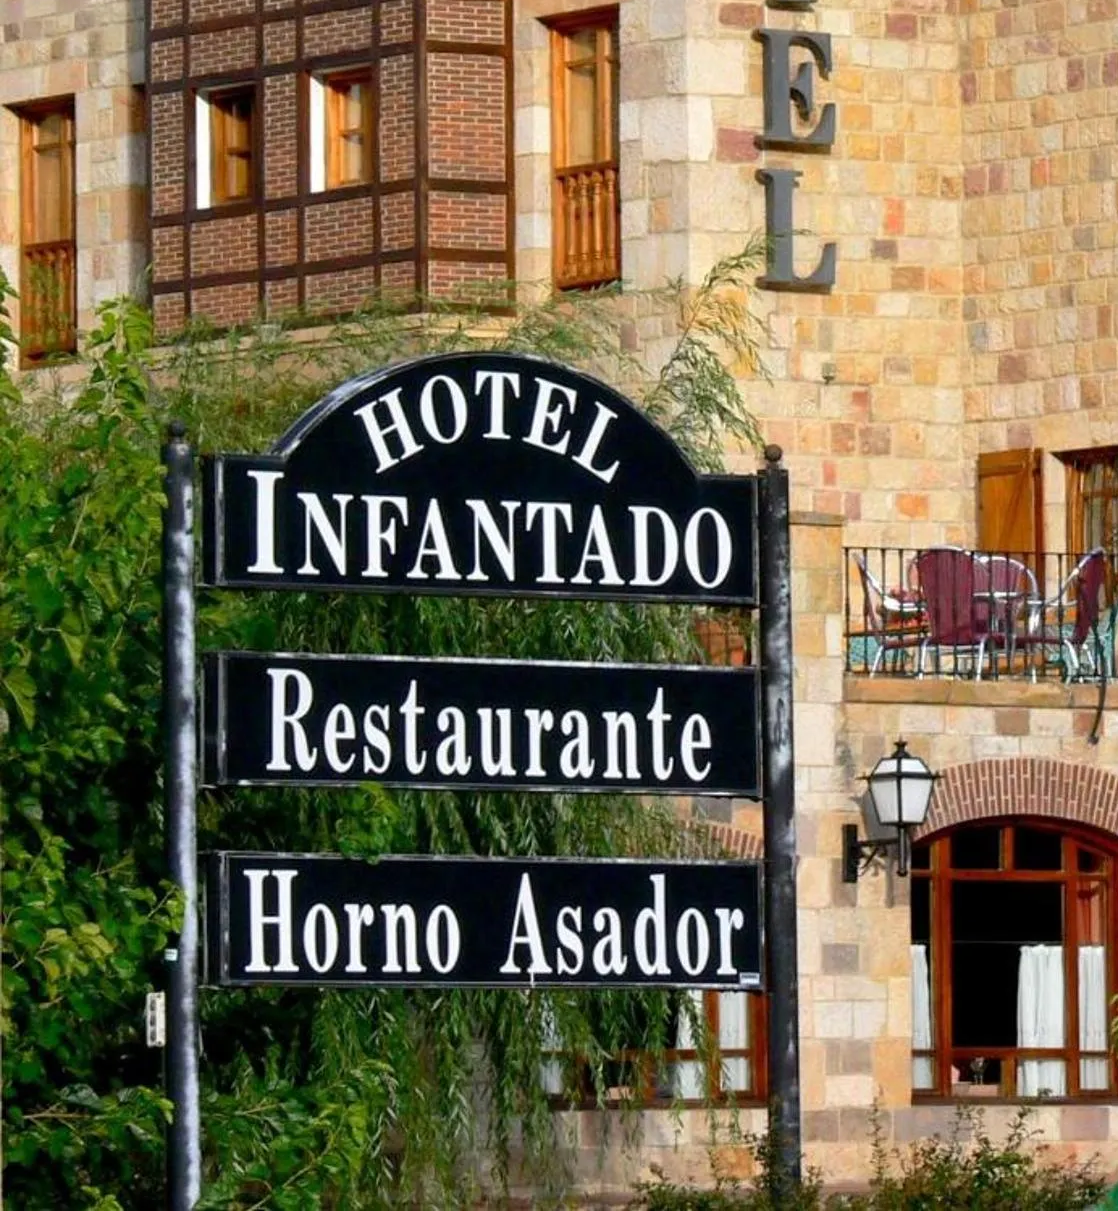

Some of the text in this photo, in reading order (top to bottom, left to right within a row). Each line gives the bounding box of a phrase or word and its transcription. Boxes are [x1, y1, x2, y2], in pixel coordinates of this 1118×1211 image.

[354, 371, 620, 484] HOTEL
[247, 471, 733, 588] INFANTADO
[266, 668, 712, 782] Restaurante
[244, 869, 744, 976] Horno Asador
